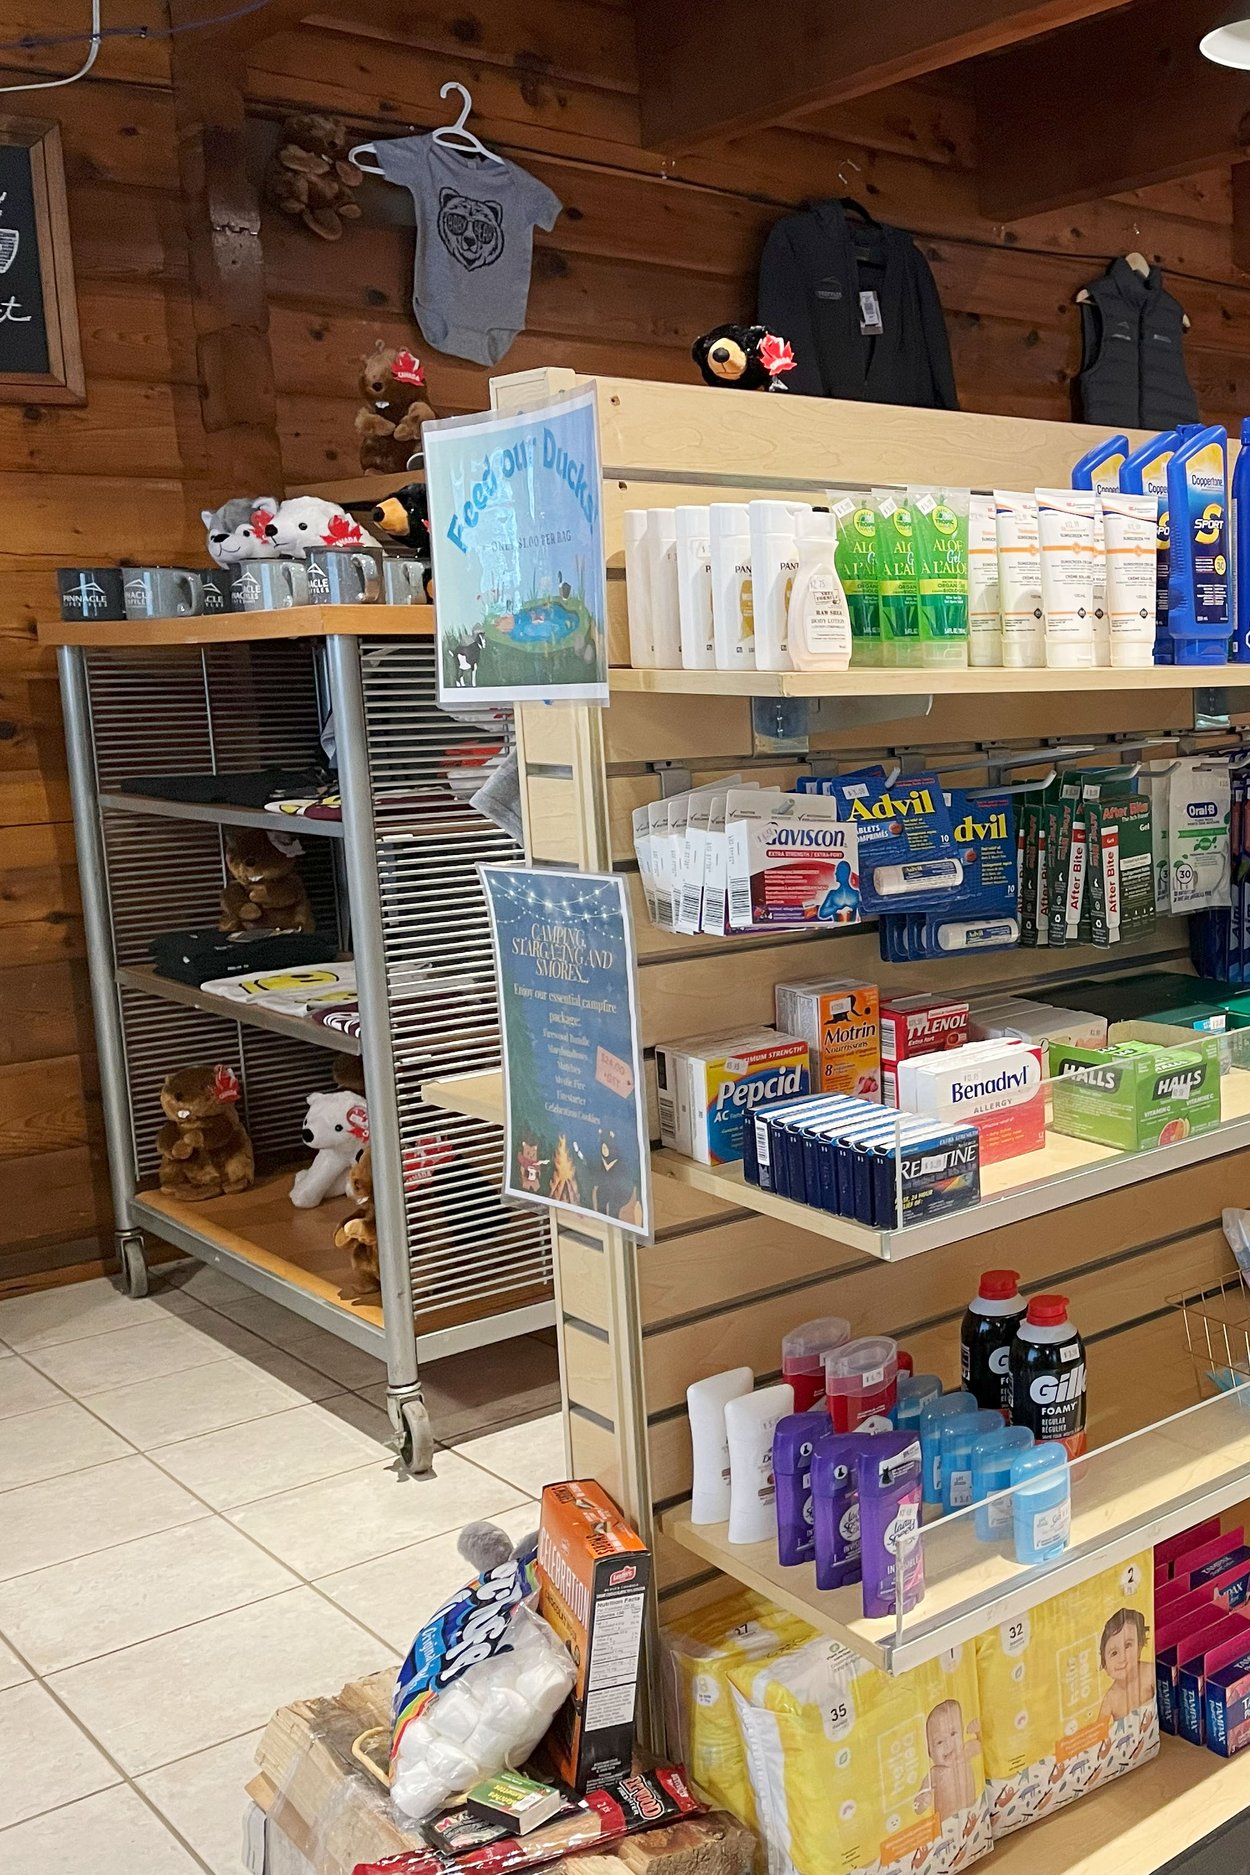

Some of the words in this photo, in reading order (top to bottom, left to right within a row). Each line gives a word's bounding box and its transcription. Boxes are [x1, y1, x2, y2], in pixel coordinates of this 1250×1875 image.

[1192, 474, 1223, 487] Coppertone
[447, 455, 498, 554] Feed
[1194, 519, 1224, 530] SPORT
[541, 533, 556, 546] PER
[934, 539, 963, 552] ALOE
[921, 561, 931, 574] À
[847, 790, 935, 822] Advil
[1103, 807, 1127, 820] After
[1130, 802, 1149, 813] Bite
[941, 835, 949, 843] 10
[1073, 847, 1083, 872] Bite
[1107, 852, 1115, 877] Bite
[1179, 870, 1191, 879] 30
[1071, 877, 1081, 910] After
[587, 950, 613, 970] AND
[514, 983, 533, 1000] Enjoy
[534, 989, 547, 1000] our
[549, 991, 581, 1007] essential
[582, 997, 617, 1014] campfire
[824, 1024, 876, 1046] Motrin
[907, 1014, 967, 1040] TYLENOL
[768, 1046, 802, 1059] STRENGTH
[825, 1063, 833, 1076] 8
[1063, 1063, 1115, 1089] HALLS
[717, 1064, 803, 1110] Pepcid
[952, 1066, 1027, 1103] Benadryl
[1158, 1070, 1202, 1095] HALLS
[973, 1098, 1012, 1114] ALLERGY
[1144, 1108, 1164, 1118] VITAMIN
[714, 1110, 729, 1122] AC
[1042, 1403, 1076, 1415] FOAMY
[1127, 1567, 1135, 1584] 2
[597, 1599, 623, 1608] Nutrition
[1009, 1623, 1024, 1639] 32
[830, 1703, 848, 1721] 35
[1215, 1702, 1226, 1742] TAMPAX
